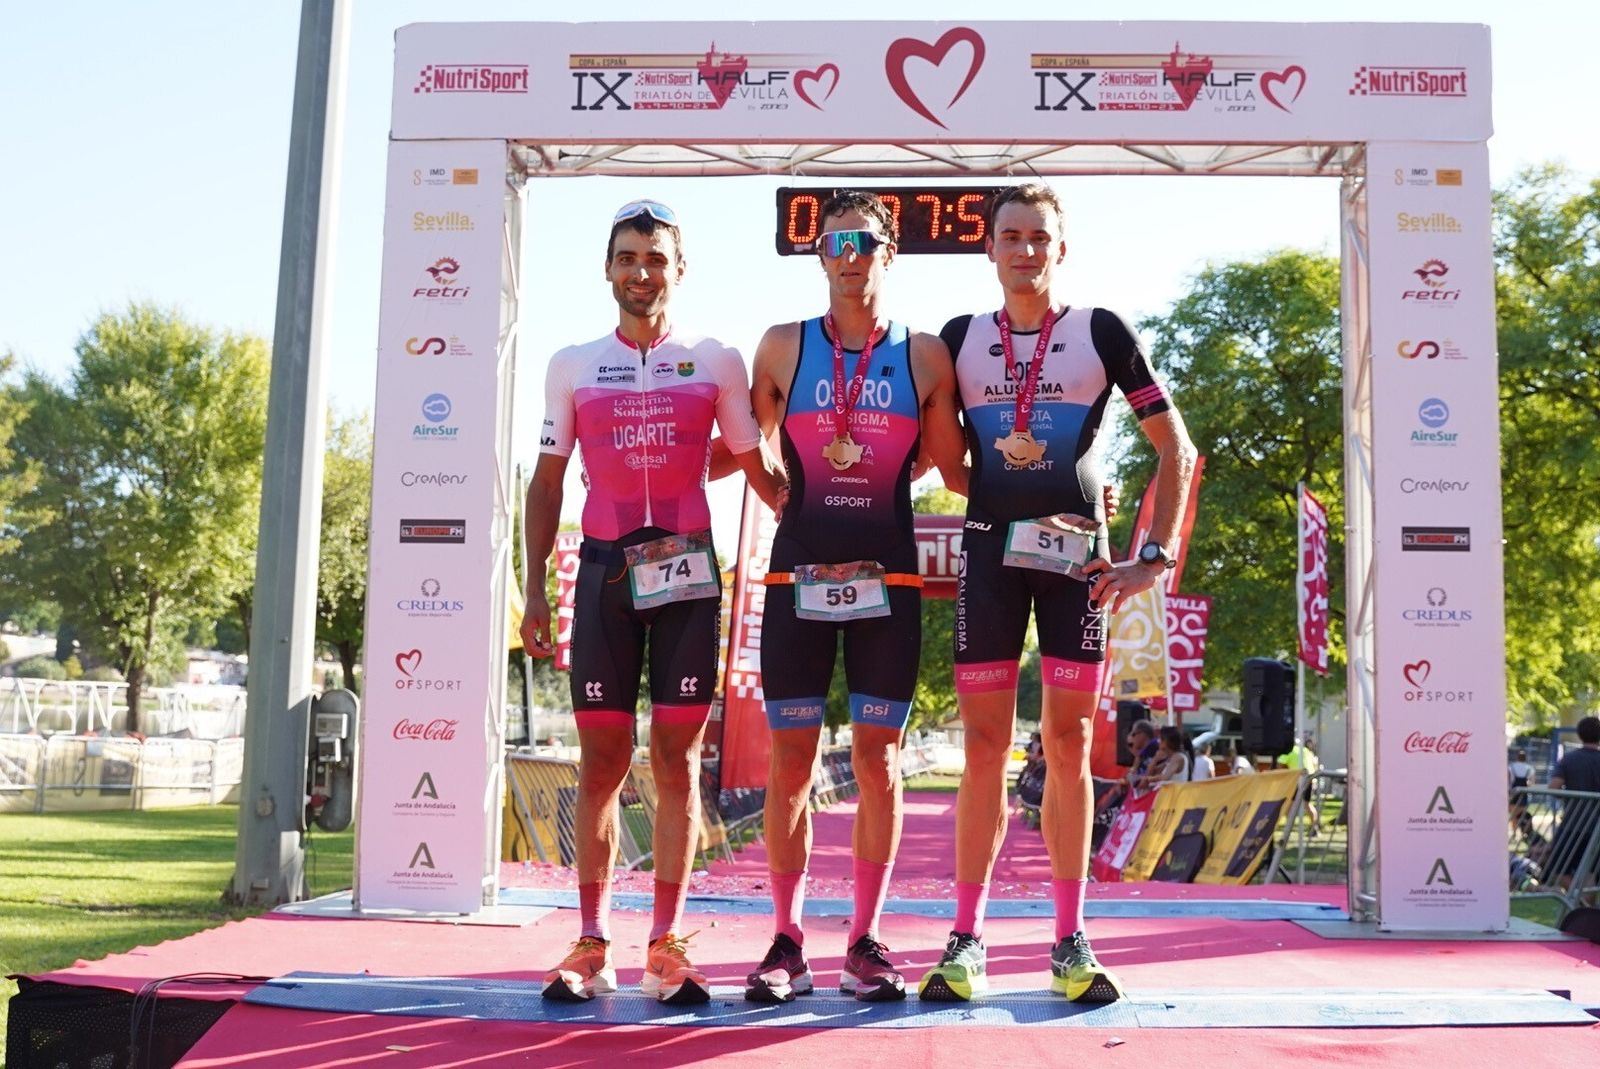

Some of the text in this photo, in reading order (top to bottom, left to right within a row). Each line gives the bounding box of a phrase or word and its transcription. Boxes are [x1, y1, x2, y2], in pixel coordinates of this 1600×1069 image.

[433, 67, 529, 93] NutriSport
[644, 71, 790, 86] NutriSport HALF
[1109, 73, 1256, 87] NutriSport HALF
[1369, 70, 1467, 96] NutriSport
[571, 72, 633, 111] IX
[635, 87, 789, 100] TRIATLÓN DE SEVILLA
[1034, 72, 1097, 111] IX
[1099, 88, 1256, 102] TRIATLÓN DE SEVILLA
[429, 168, 446, 176] IMD
[1411, 168, 1428, 176] IMD
[815, 379, 892, 408] ORO
[984, 383, 1064, 396] ALUSGMA
[816, 413, 889, 427] ALSIGMA
[1000, 410, 1053, 423] PEOTA
[412, 425, 460, 437] AireSur
[612, 422, 677, 451] UGARTE
[1410, 430, 1459, 442] AireSur
[824, 495, 873, 508] GSPORT
[964, 520, 992, 531] 2XU
[1036, 530, 1065, 554] 51
[658, 558, 692, 584] 74
[825, 585, 858, 607] 59
[396, 600, 464, 612] CREDUS
[1080, 571, 1103, 651] PEÑOA
[1166, 596, 1208, 612] EVILLA
[956, 579, 968, 652] ALUSIGMA
[1402, 609, 1473, 621] CREDUS
[1054, 666, 1081, 681] psi
[862, 703, 890, 718] psi
